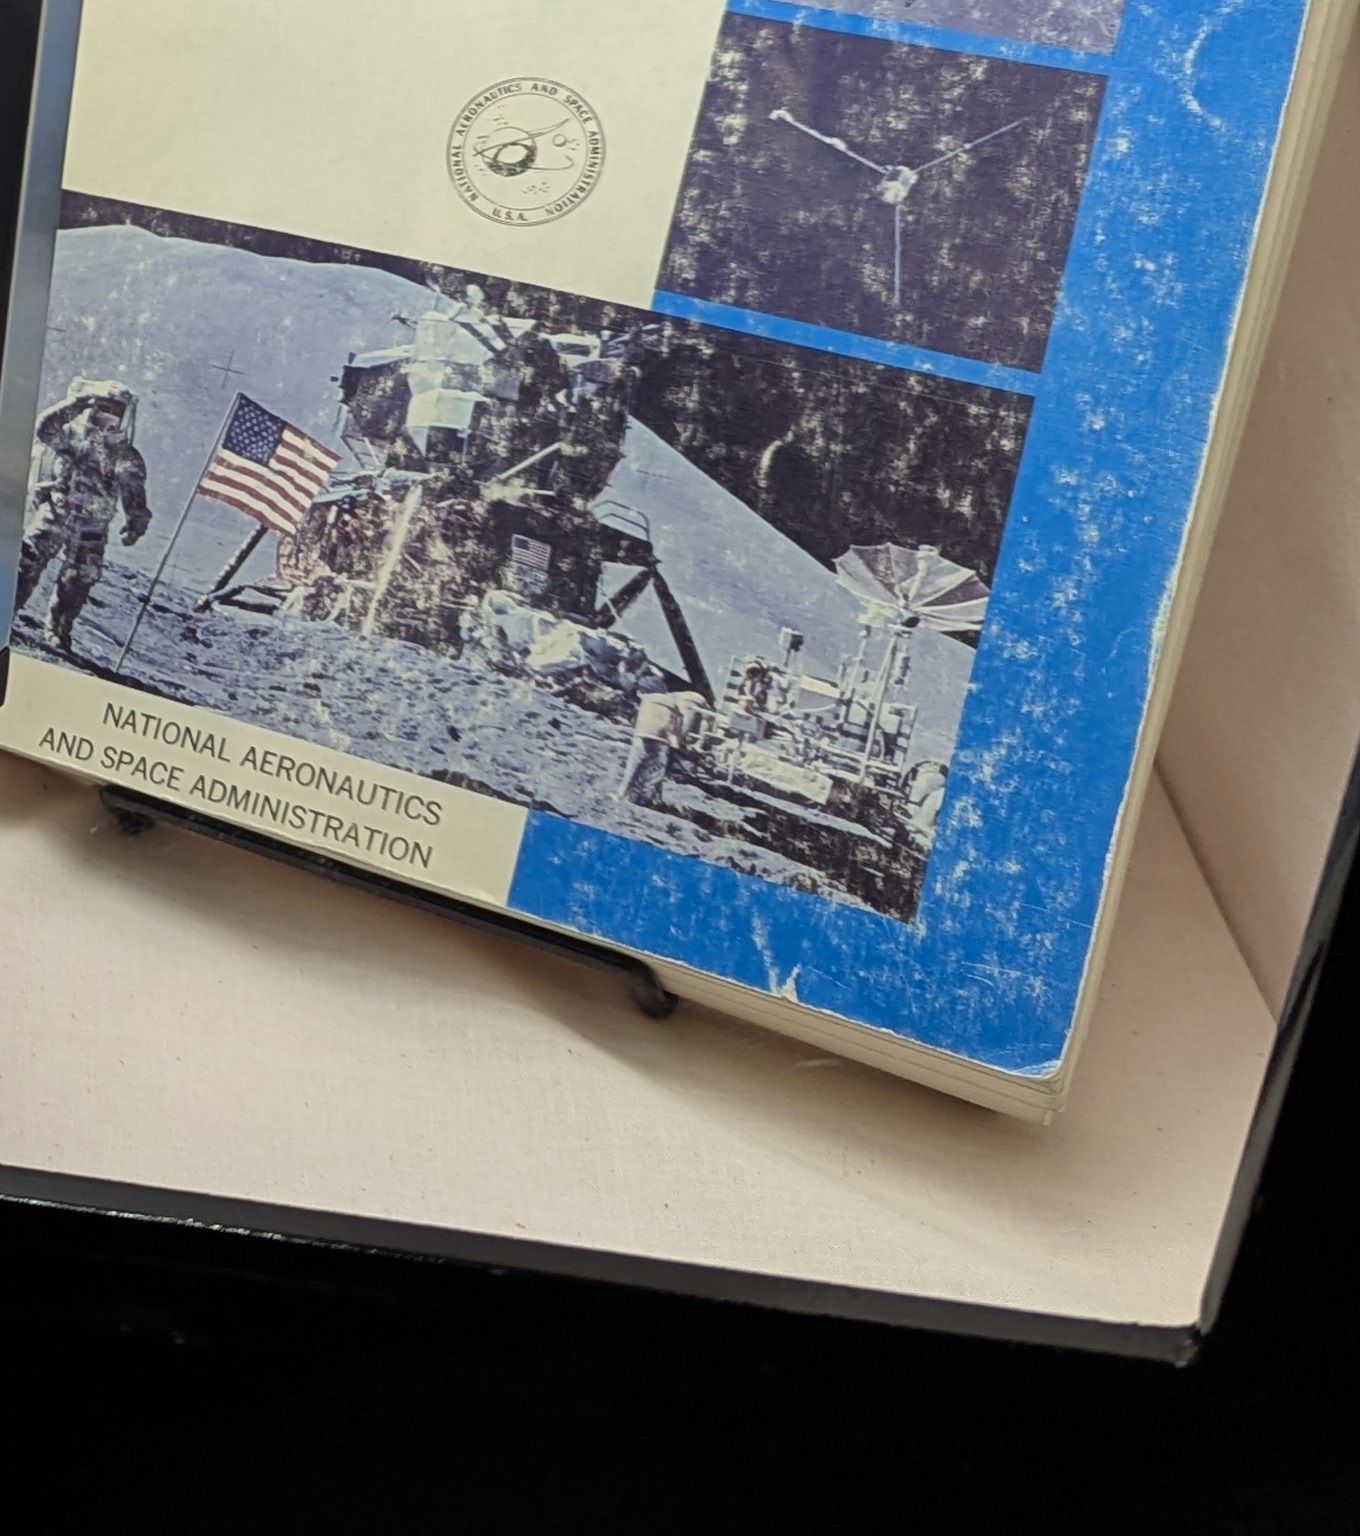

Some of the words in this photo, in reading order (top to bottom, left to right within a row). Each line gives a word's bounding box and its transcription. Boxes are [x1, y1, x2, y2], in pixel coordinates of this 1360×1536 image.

[455, 82, 522, 137] AERONAUTICS
[530, 83, 558, 96] AND
[563, 94, 593, 125] SPACE
[451, 144, 480, 202] NATIONAL
[544, 130, 600, 216] ADMINISTRATION
[102, 701, 232, 763] NATIONAL
[239, 746, 443, 826] AERONAUTICS
[38, 726, 95, 762] AND
[100, 745, 184, 792] SPACE
[188, 775, 434, 869] ADMINISTRATION
